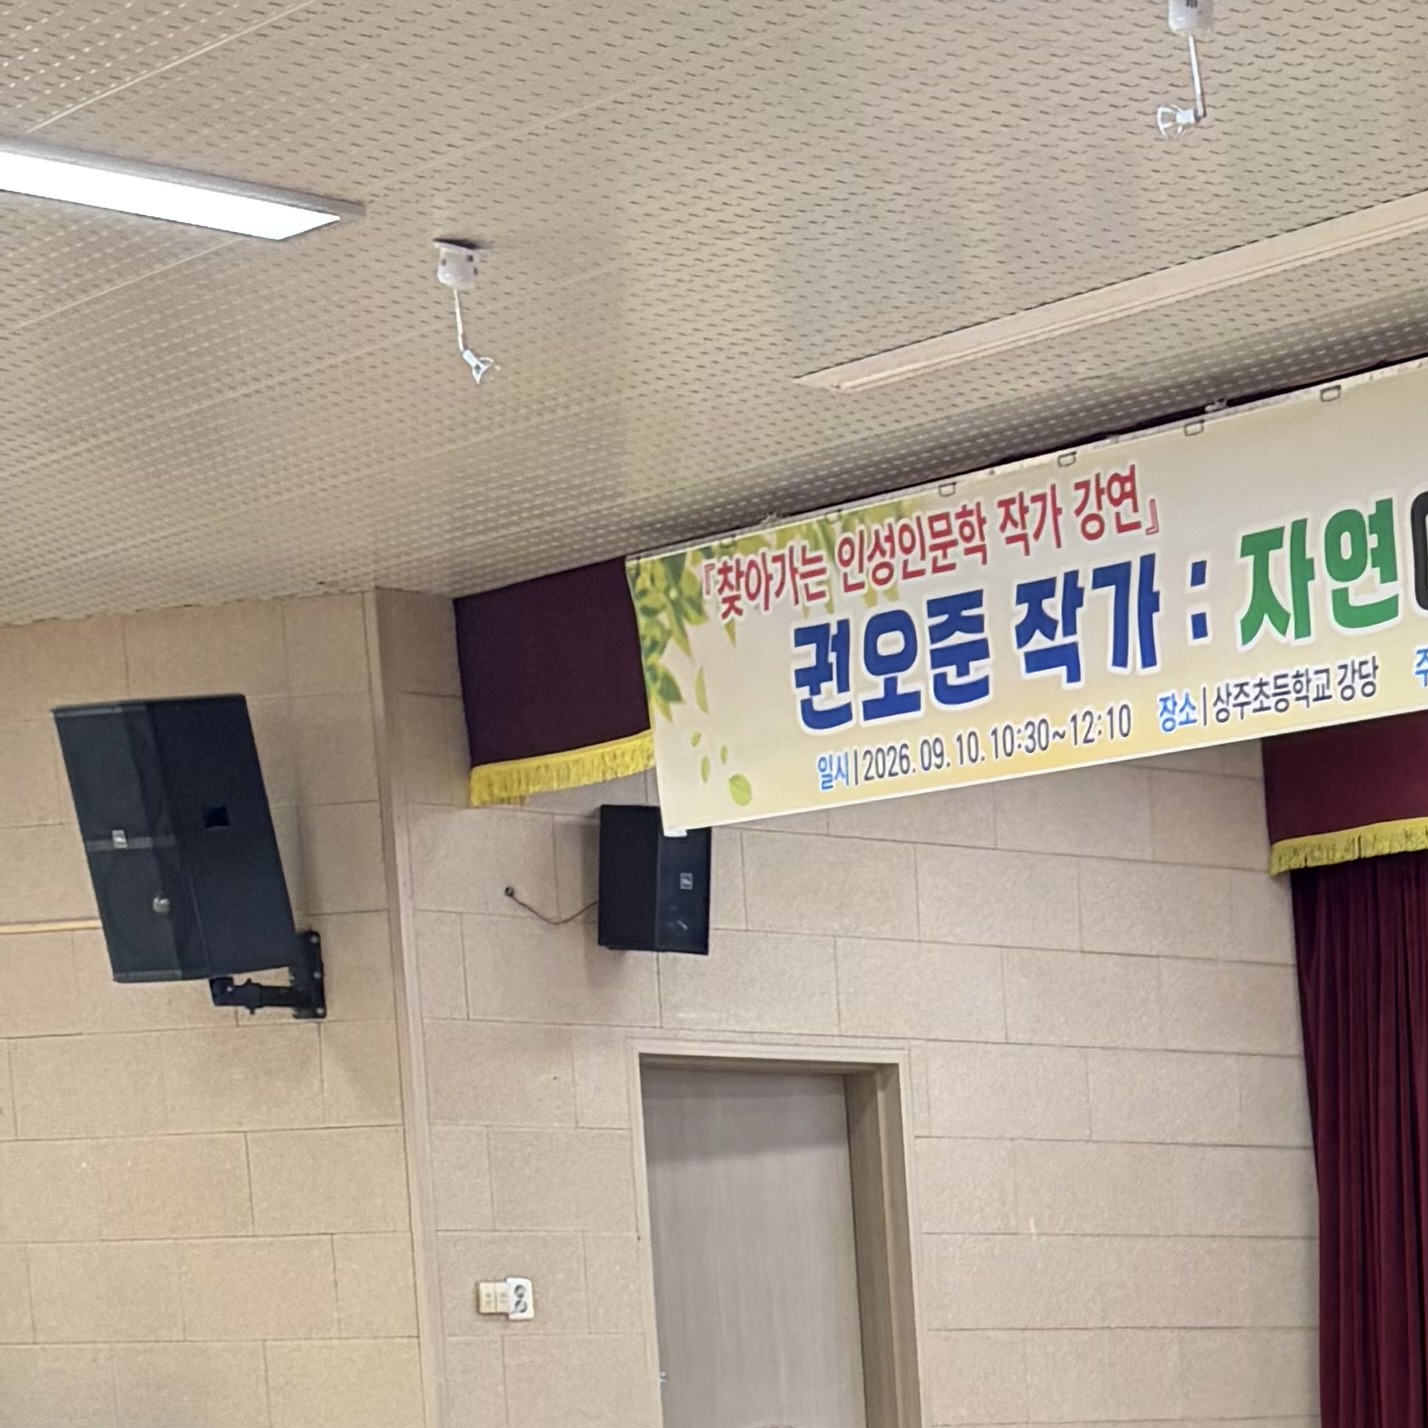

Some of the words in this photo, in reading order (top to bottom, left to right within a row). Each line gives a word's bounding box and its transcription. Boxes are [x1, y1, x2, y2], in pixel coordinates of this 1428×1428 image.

[836, 502, 989, 595] 인성인문학
[998, 484, 1063, 556] 작가
[793, 588, 991, 730] 권오준
[1014, 553, 1159, 684] 작가
[816, 754, 850, 791] 일시
[1158, 691, 1198, 734] 장소
[1213, 668, 1333, 726] 상주초등학교
[1335, 656, 1380, 703] 강당
